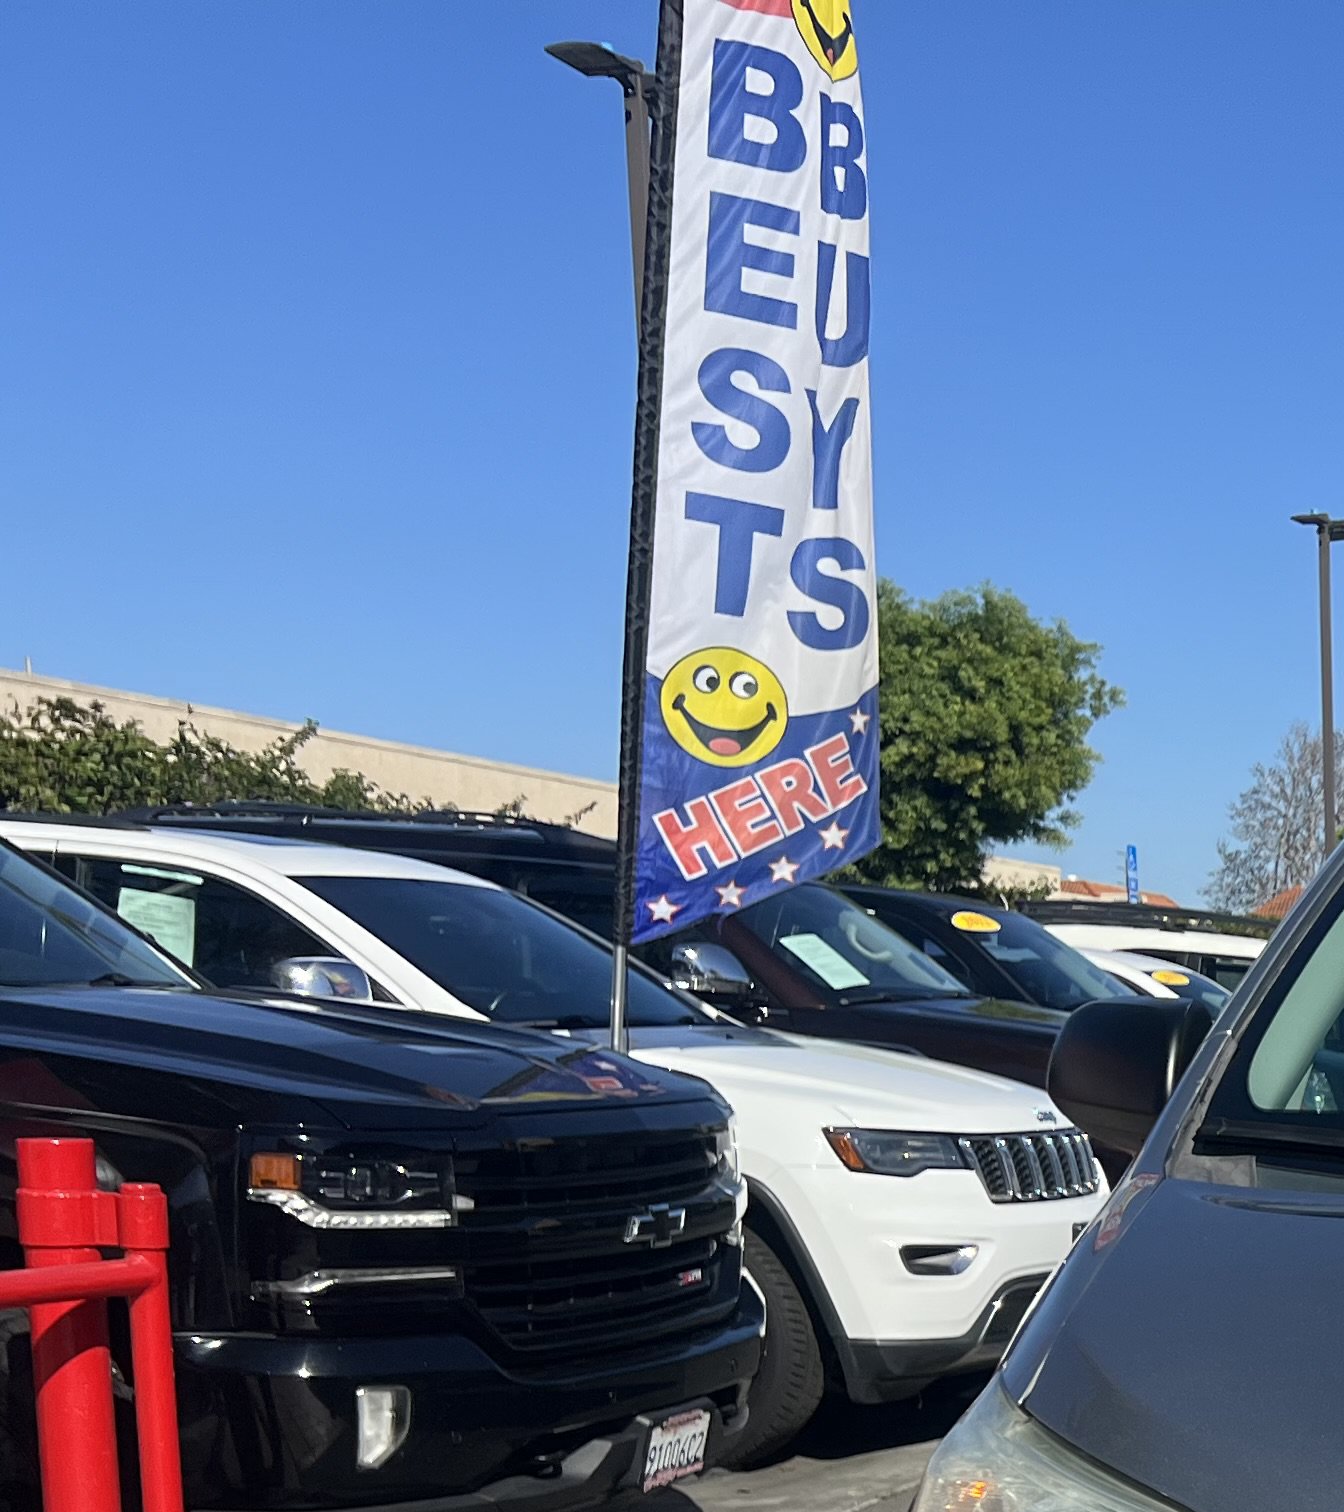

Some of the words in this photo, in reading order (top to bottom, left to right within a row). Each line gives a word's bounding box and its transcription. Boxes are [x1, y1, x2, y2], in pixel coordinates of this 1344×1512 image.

[685, 38, 807, 617] BEST
[787, 92, 870, 651] BUYS
[652, 731, 868, 882] HERE
